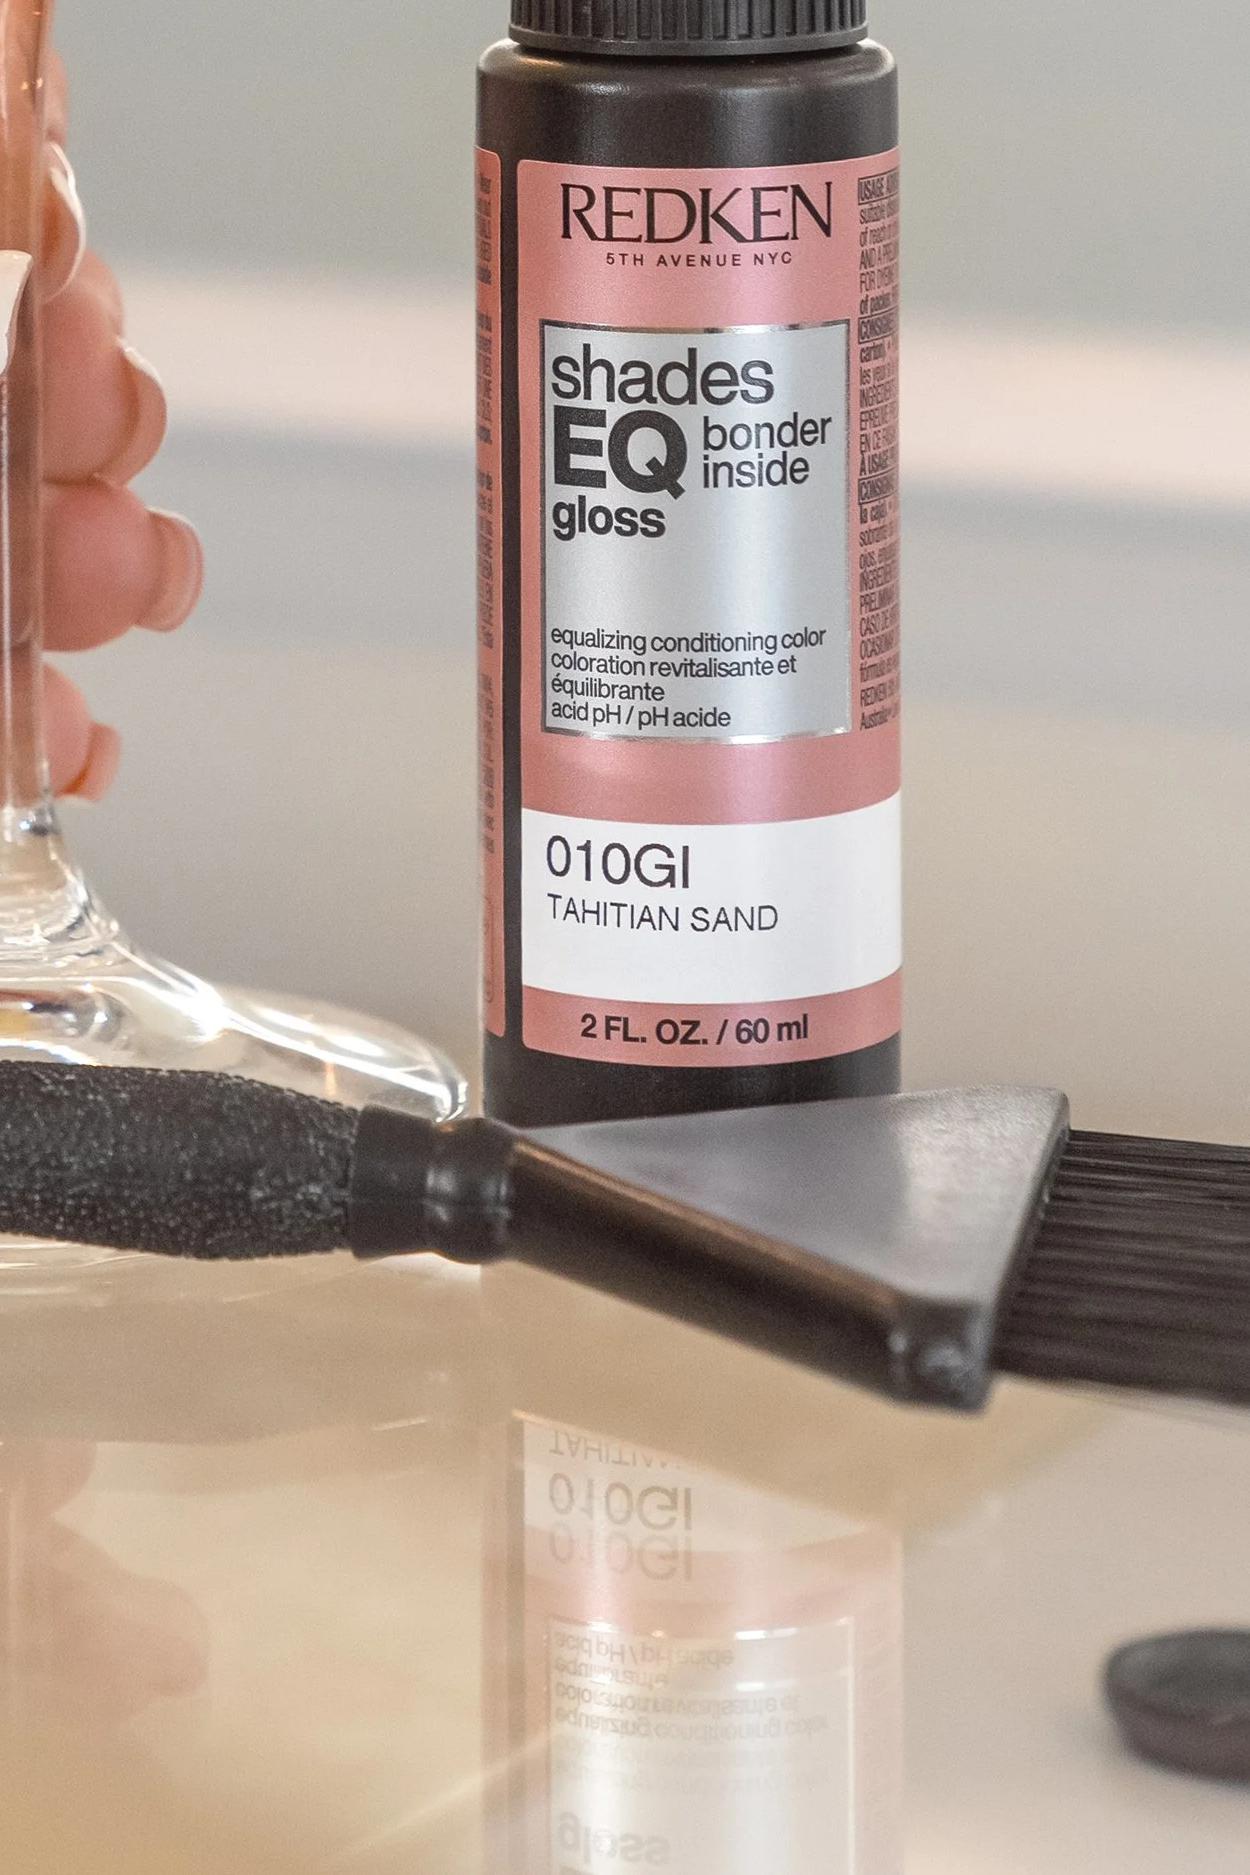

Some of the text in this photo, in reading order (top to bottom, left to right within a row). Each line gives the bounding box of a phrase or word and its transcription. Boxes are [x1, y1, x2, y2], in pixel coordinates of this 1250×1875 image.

[560, 180, 833, 245] REDKEN
[606, 251, 792, 268] 5TH AVENUE NYC
[551, 342, 775, 406] shades
[703, 411, 833, 452] bonder
[553, 405, 688, 500] EQ
[703, 453, 810, 489] inside
[551, 494, 667, 542] gloss
[551, 626, 827, 656] equalizing conditioning color
[551, 651, 798, 677] coloration revitalisante et
[551, 672, 666, 702] équilibrante
[551, 701, 731, 731] acid pH / pH acide
[546, 835, 691, 889] 010GI
[547, 892, 779, 933] TAHITIAN SAND
[580, 1013, 809, 1046] 2 FL. OZ. / 60 ml
